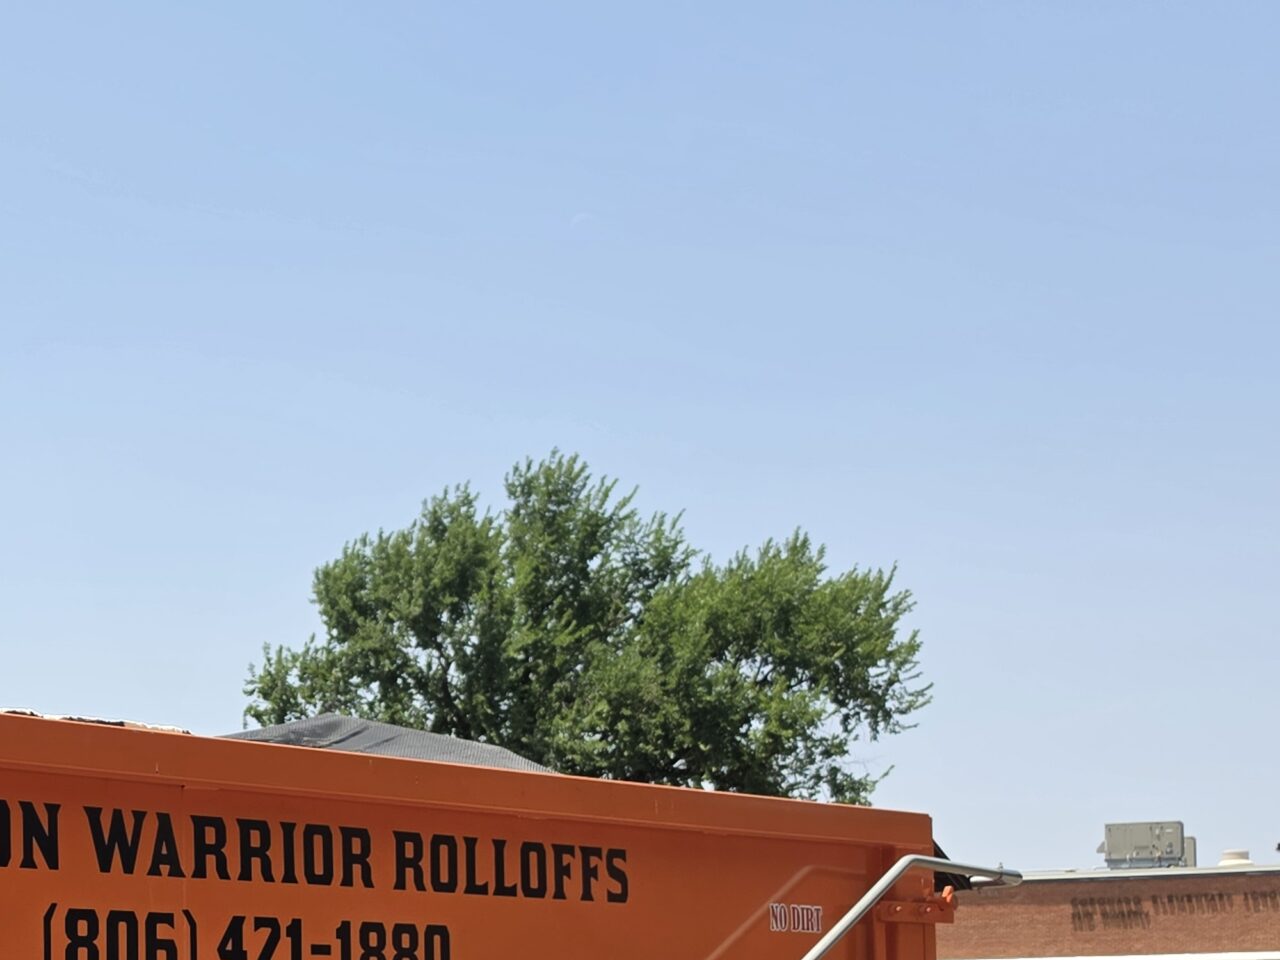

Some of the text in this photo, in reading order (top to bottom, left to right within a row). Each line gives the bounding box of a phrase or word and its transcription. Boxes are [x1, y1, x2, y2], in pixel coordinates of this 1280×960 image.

[83, 805, 375, 889] WARRIOR
[392, 829, 629, 904] ROLLOFFS
[769, 904, 822, 933] NO DIRT
